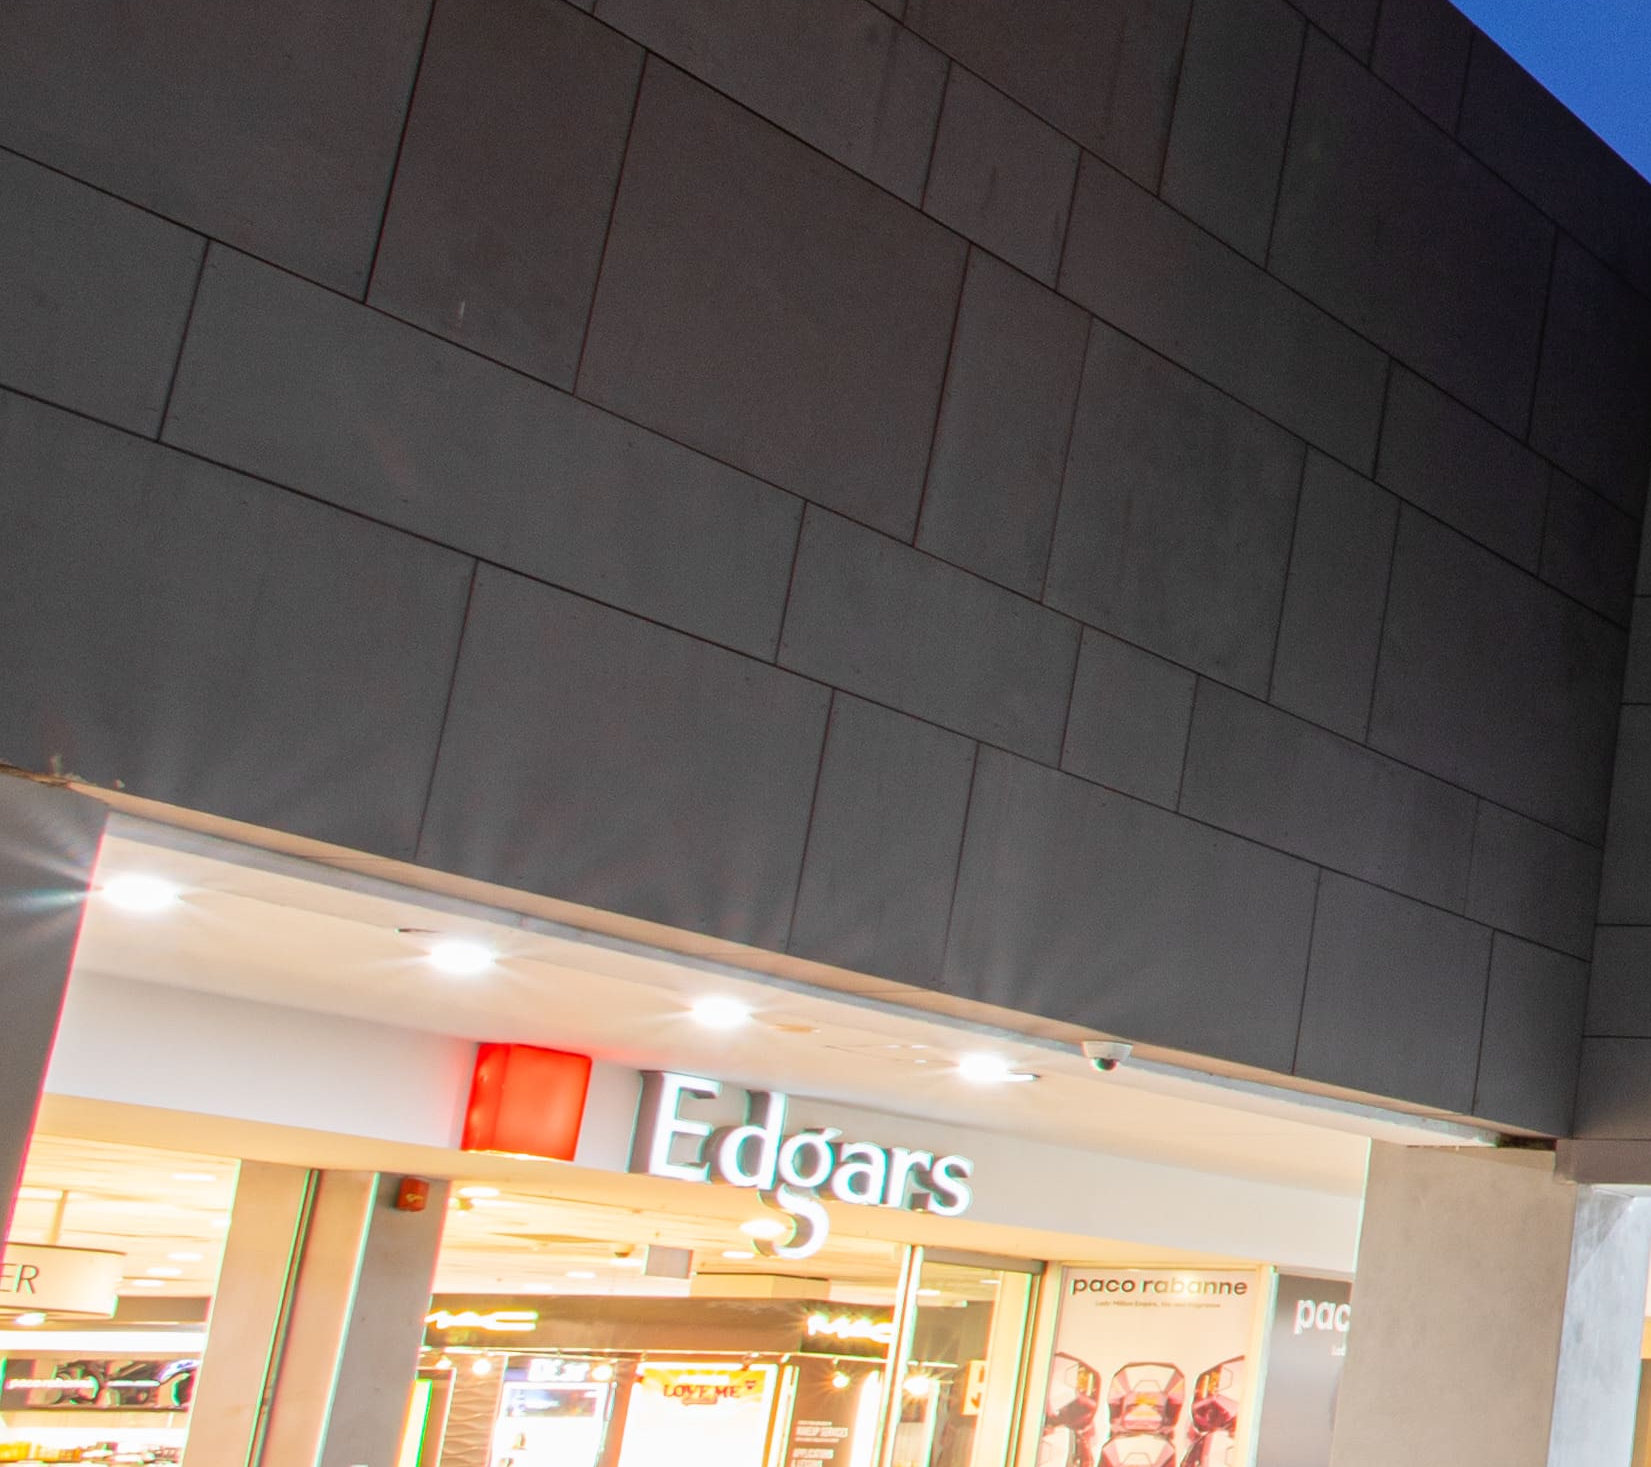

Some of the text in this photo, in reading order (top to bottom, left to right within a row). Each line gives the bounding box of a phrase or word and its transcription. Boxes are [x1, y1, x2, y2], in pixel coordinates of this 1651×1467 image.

[648, 1070, 974, 1260] Edgars
[1071, 1276, 1248, 1296] paco rabanne
[663, 1383, 741, 1399] LOVE ME
